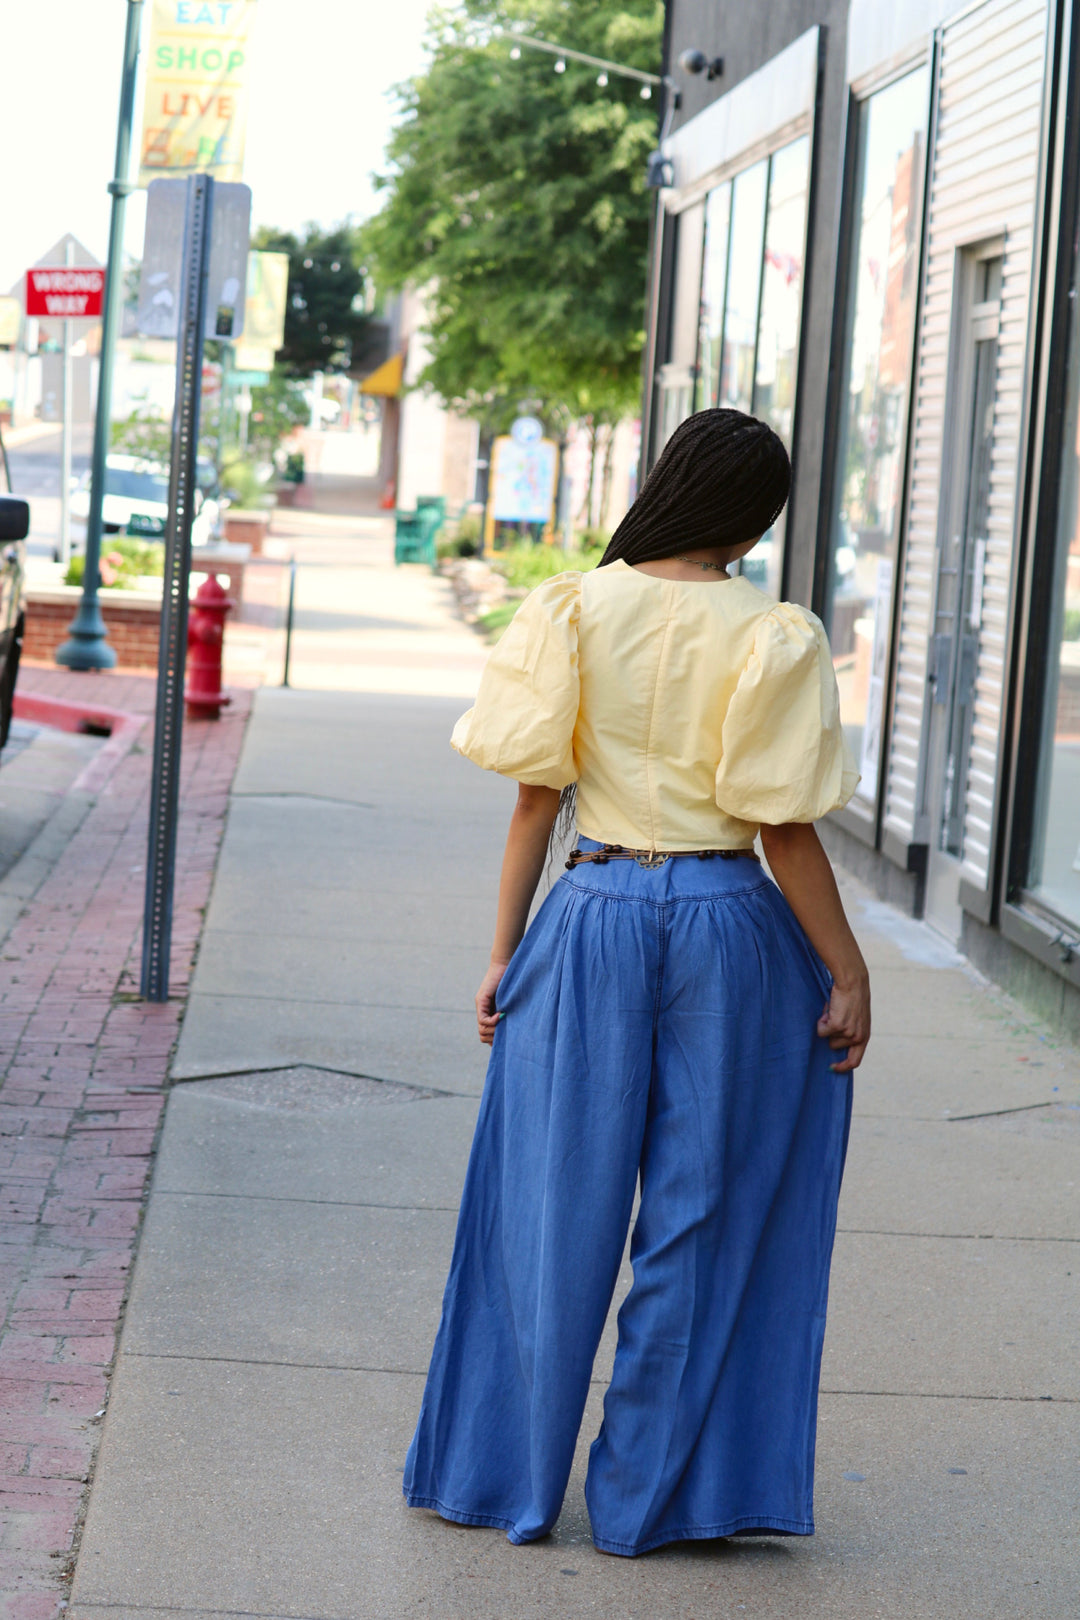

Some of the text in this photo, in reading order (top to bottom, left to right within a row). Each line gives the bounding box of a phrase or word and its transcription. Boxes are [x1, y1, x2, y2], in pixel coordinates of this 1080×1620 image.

[175, 1, 232, 25] EAT
[156, 46, 245, 72] SHOP
[162, 92, 232, 119] LIVE
[32, 271, 103, 292] WRONG
[45, 294, 89, 314] WAY
